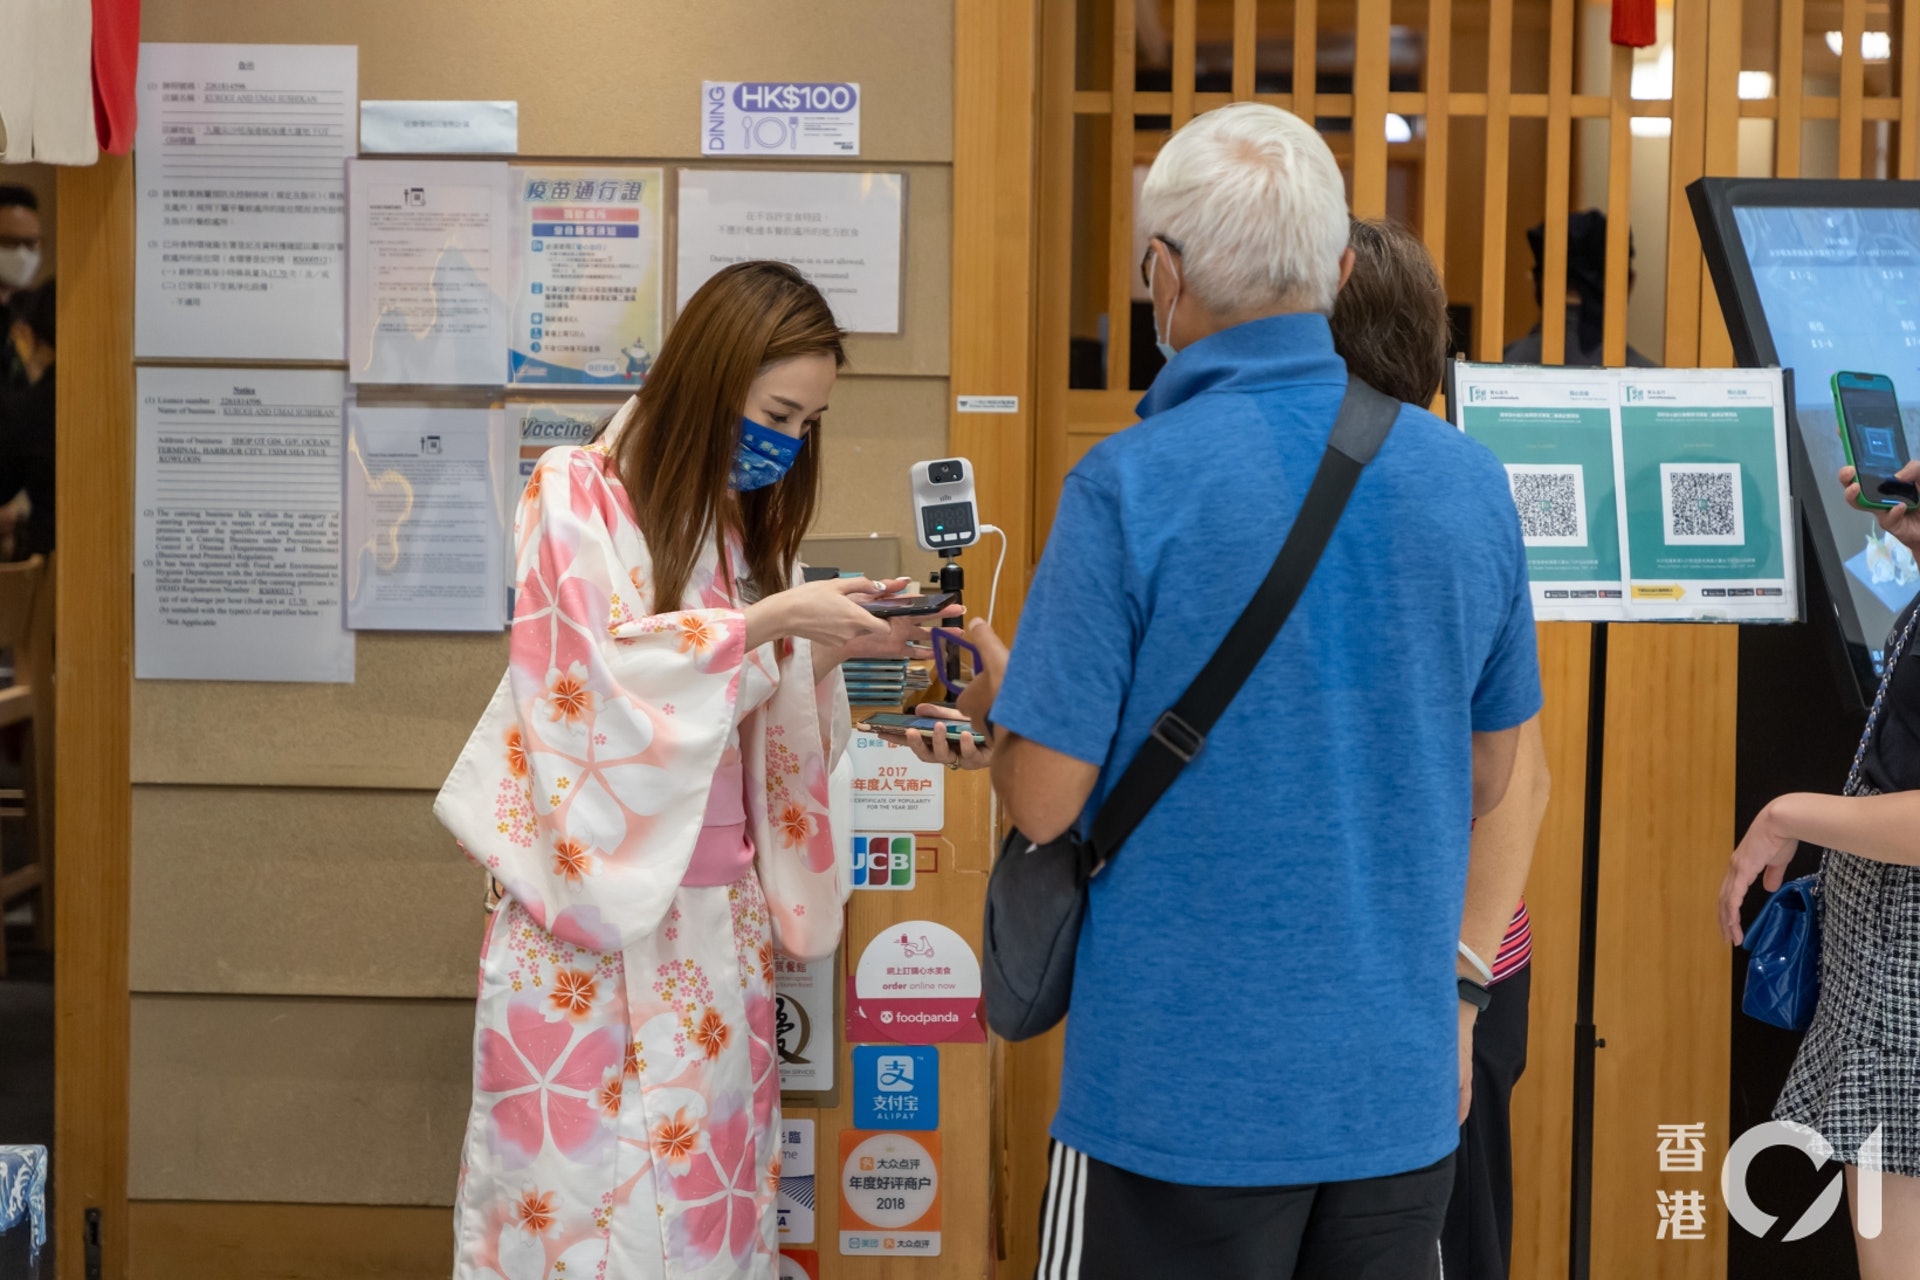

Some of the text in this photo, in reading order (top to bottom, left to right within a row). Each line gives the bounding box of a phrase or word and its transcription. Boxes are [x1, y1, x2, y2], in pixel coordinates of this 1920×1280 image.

[741, 85, 850, 110] HK$100
[709, 86, 725, 151] DINING
[527, 180, 642, 200] 疫苗通行證
[522, 419, 593, 438] Vaccine
[878, 767, 908, 777] 2017
[852, 778, 932, 792] 年度人气商户
[850, 852, 909, 870] JCB
[882, 981, 957, 990] order online now
[896, 1011, 959, 1026] foodpanda
[872, 1095, 919, 1111] 支付宝
[877, 1112, 915, 1120] ALIPAY
[877, 1158, 920, 1170] 大众点评
[849, 1176, 931, 1190] 年度好评商户
[876, 1197, 905, 1210] 2018
[897, 1239, 930, 1248] 大众点评
